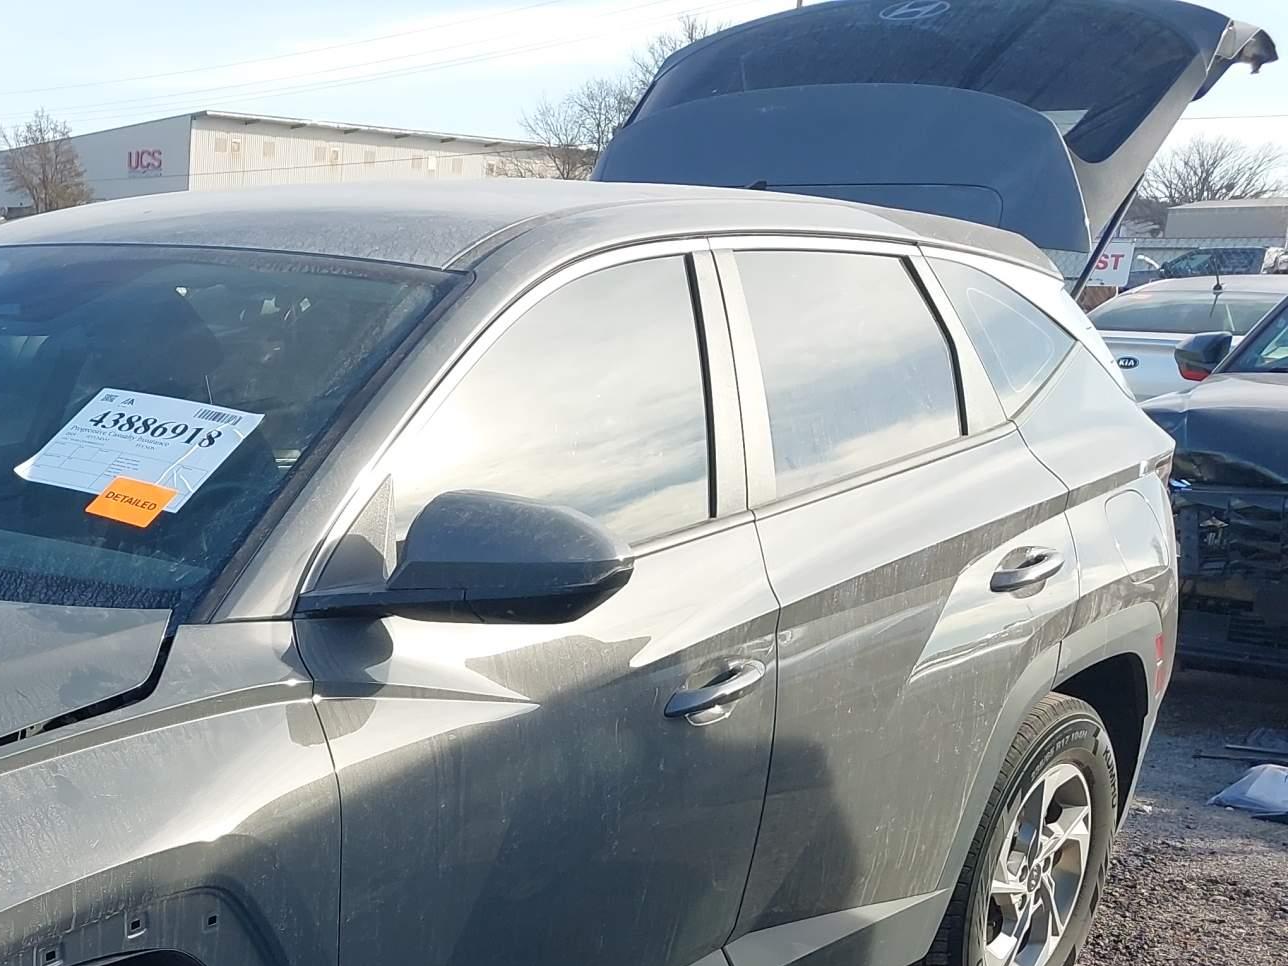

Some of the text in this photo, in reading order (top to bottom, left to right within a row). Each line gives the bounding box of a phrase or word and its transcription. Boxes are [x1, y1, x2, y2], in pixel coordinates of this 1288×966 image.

[128, 150, 162, 170] UCS
[89, 410, 222, 448] 43886918
[104, 490, 157, 511] DETAILED
[1102, 745, 1118, 809] KUMHO
